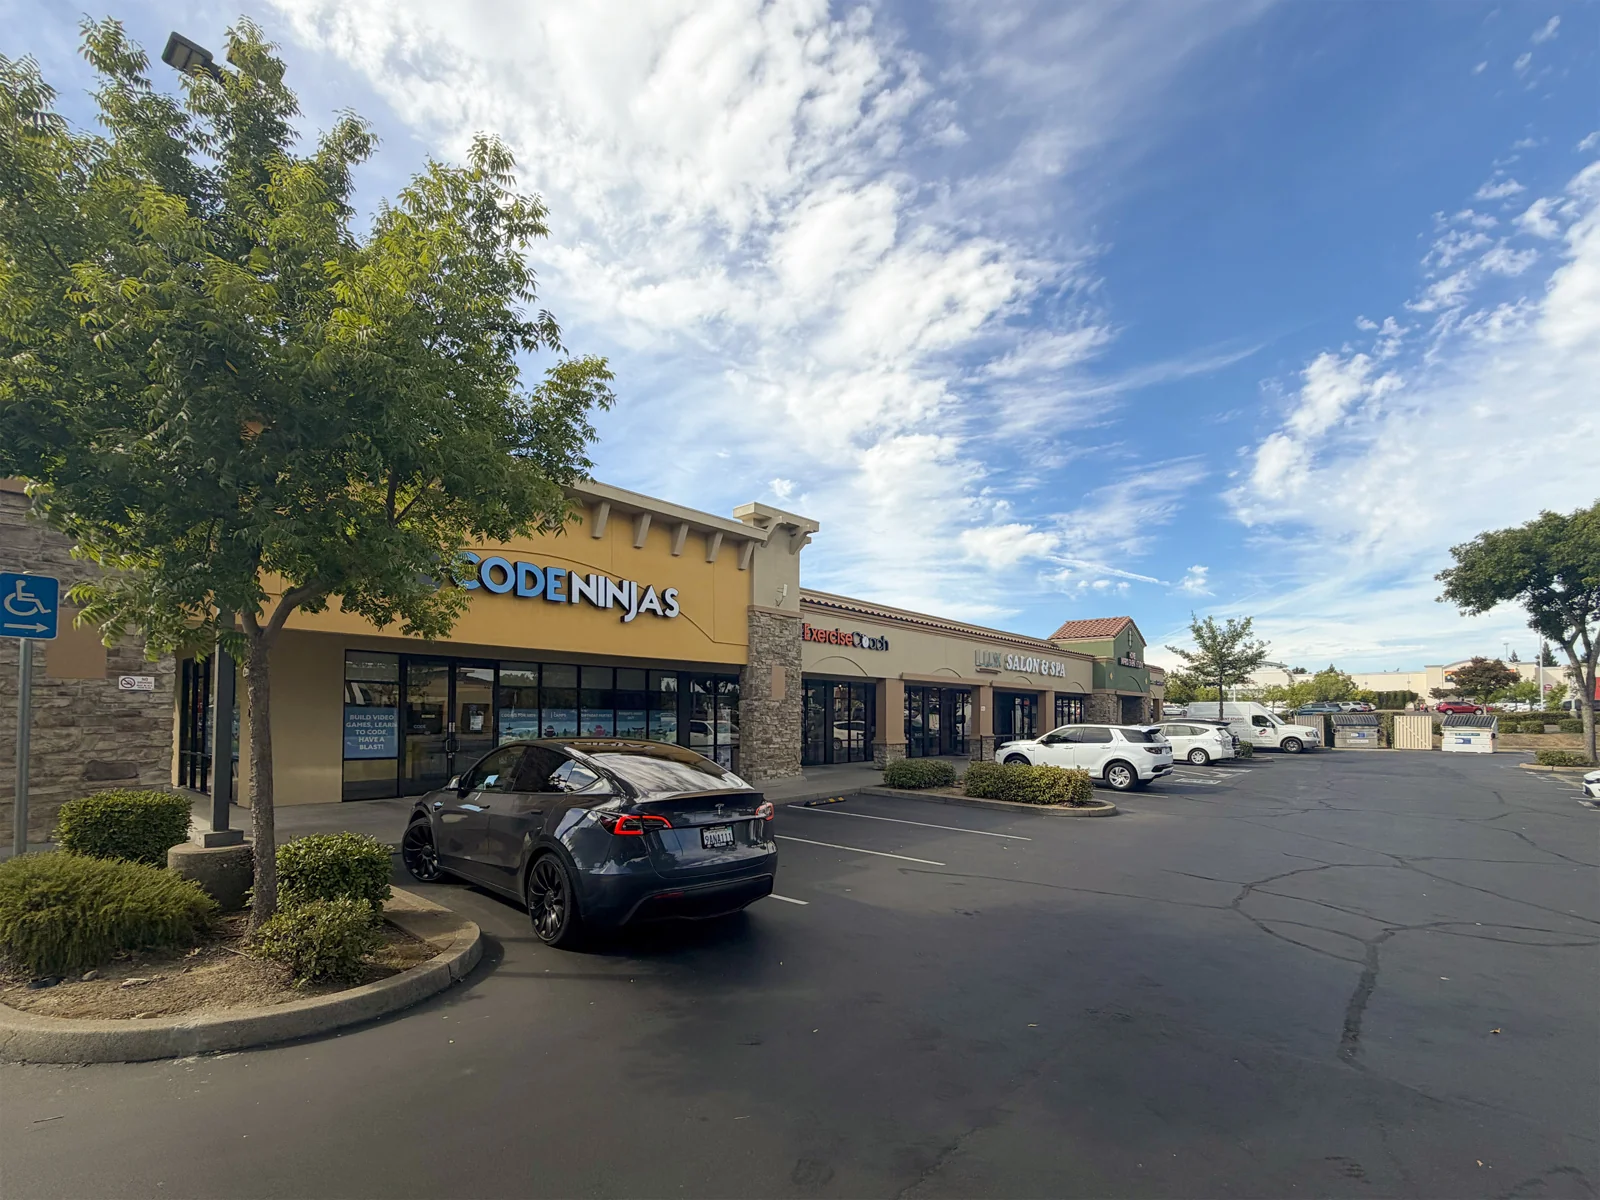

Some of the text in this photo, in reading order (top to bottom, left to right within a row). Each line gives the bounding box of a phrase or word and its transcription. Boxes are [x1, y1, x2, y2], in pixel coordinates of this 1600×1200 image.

[568, 570, 681, 624] NINJAS
[1004, 653, 1040, 674] SALON
[1040, 659, 1049, 675] &
[1049, 661, 1066, 677] SPA
